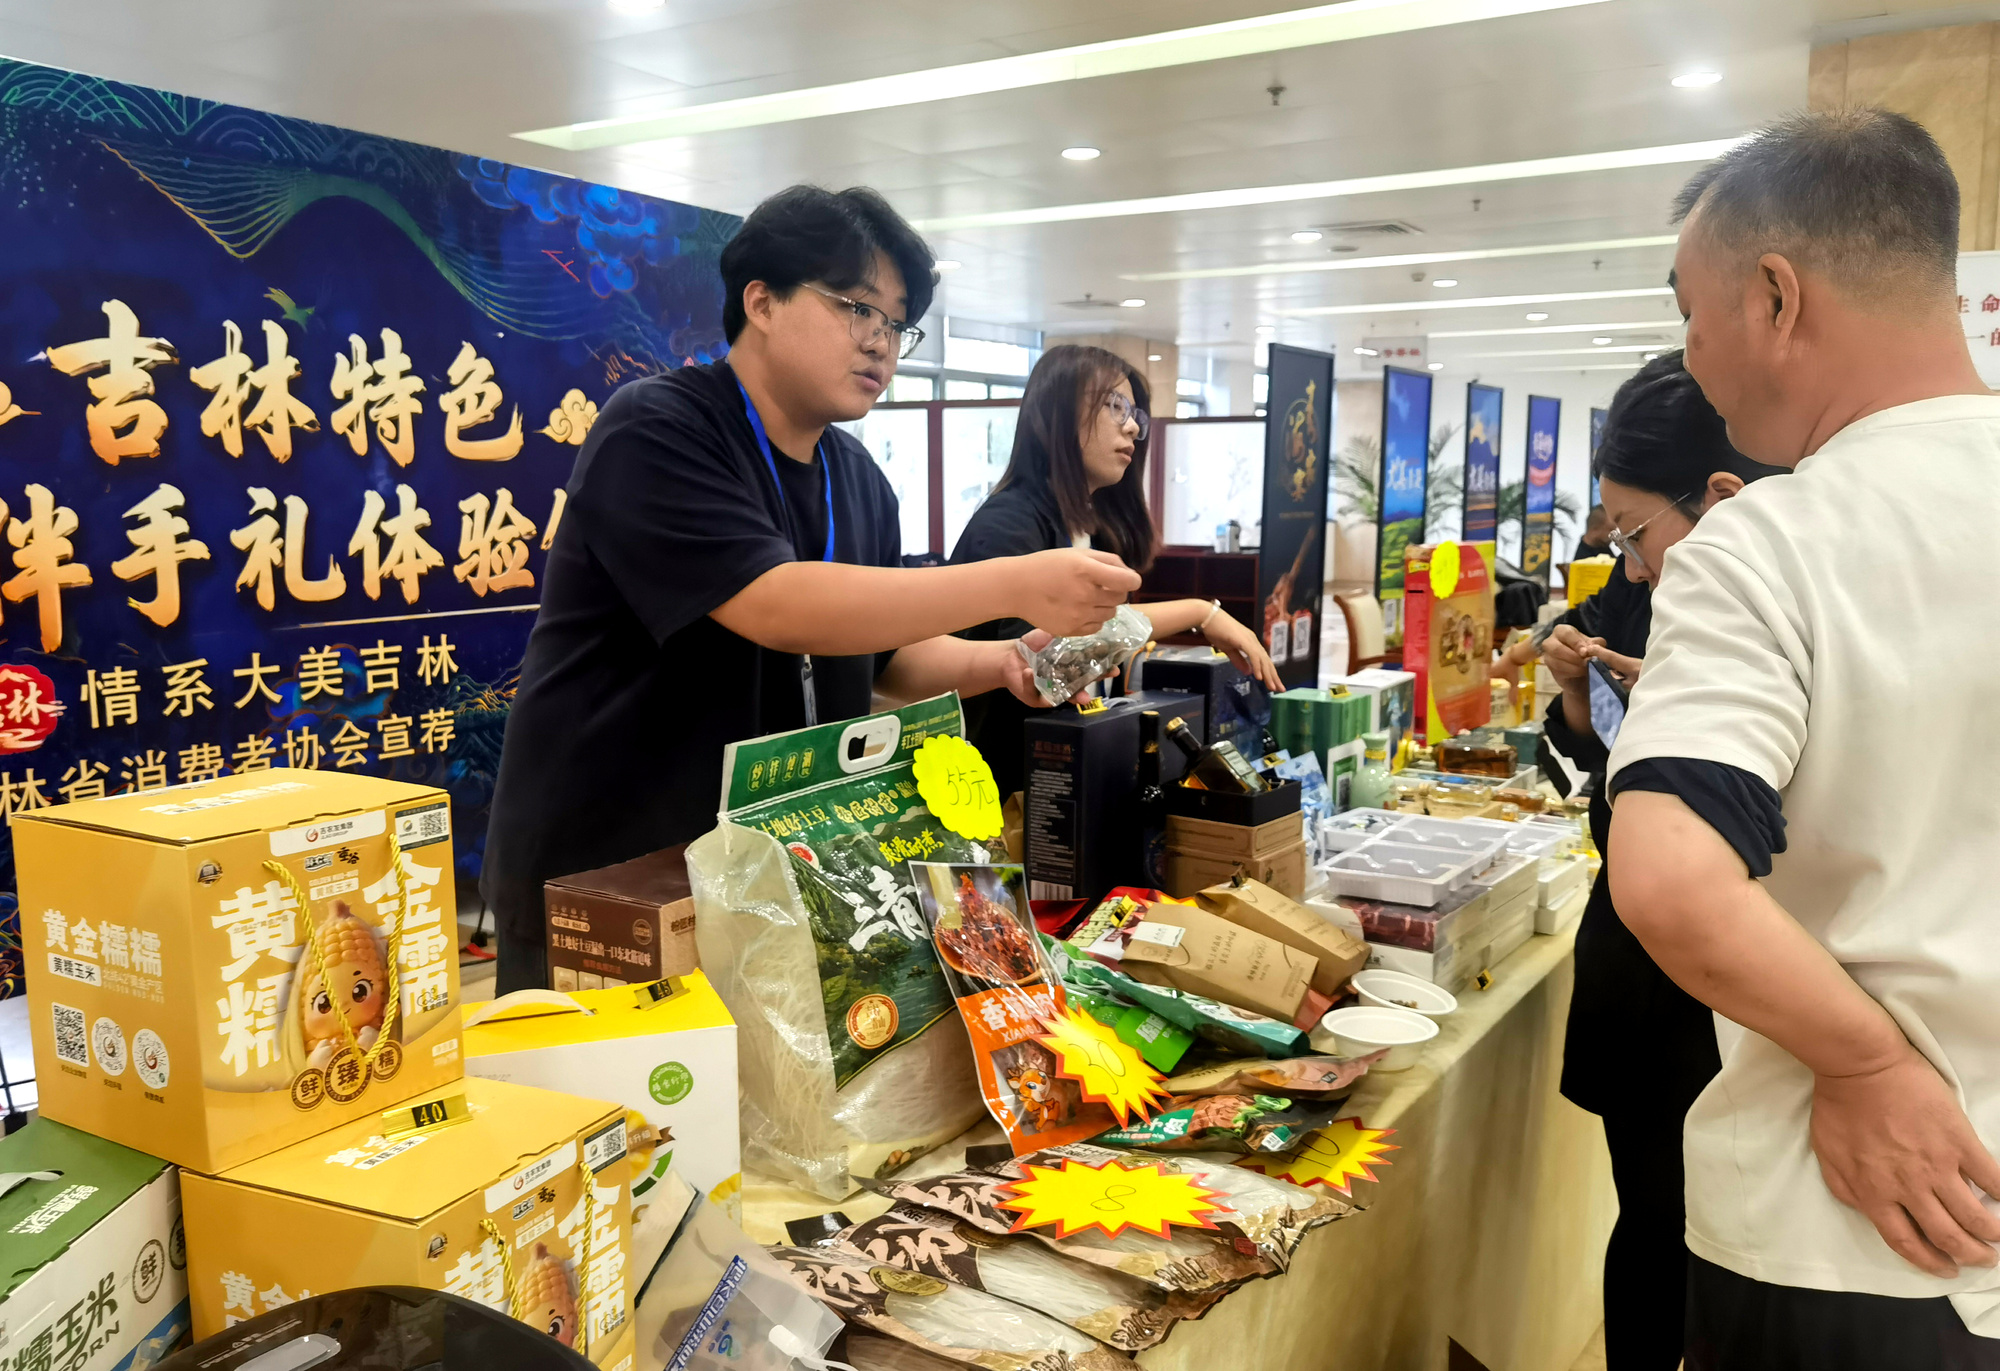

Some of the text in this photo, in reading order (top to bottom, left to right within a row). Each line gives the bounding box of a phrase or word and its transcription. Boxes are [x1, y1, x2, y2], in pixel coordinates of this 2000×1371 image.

[48, 299, 524, 467] 吉林特色
[0, 484, 568, 652] 伴手礼体验
[81, 634, 459, 729] 情系大美吉林
[946, 765, 995, 811] 55元
[751, 804, 830, 838] 土地好土豆
[879, 828, 945, 867] 爽滑耐煮
[42, 908, 163, 978] 黄金糯糯
[300, 1077, 319, 1098] 鲜
[419, 1102, 444, 1126] 40
